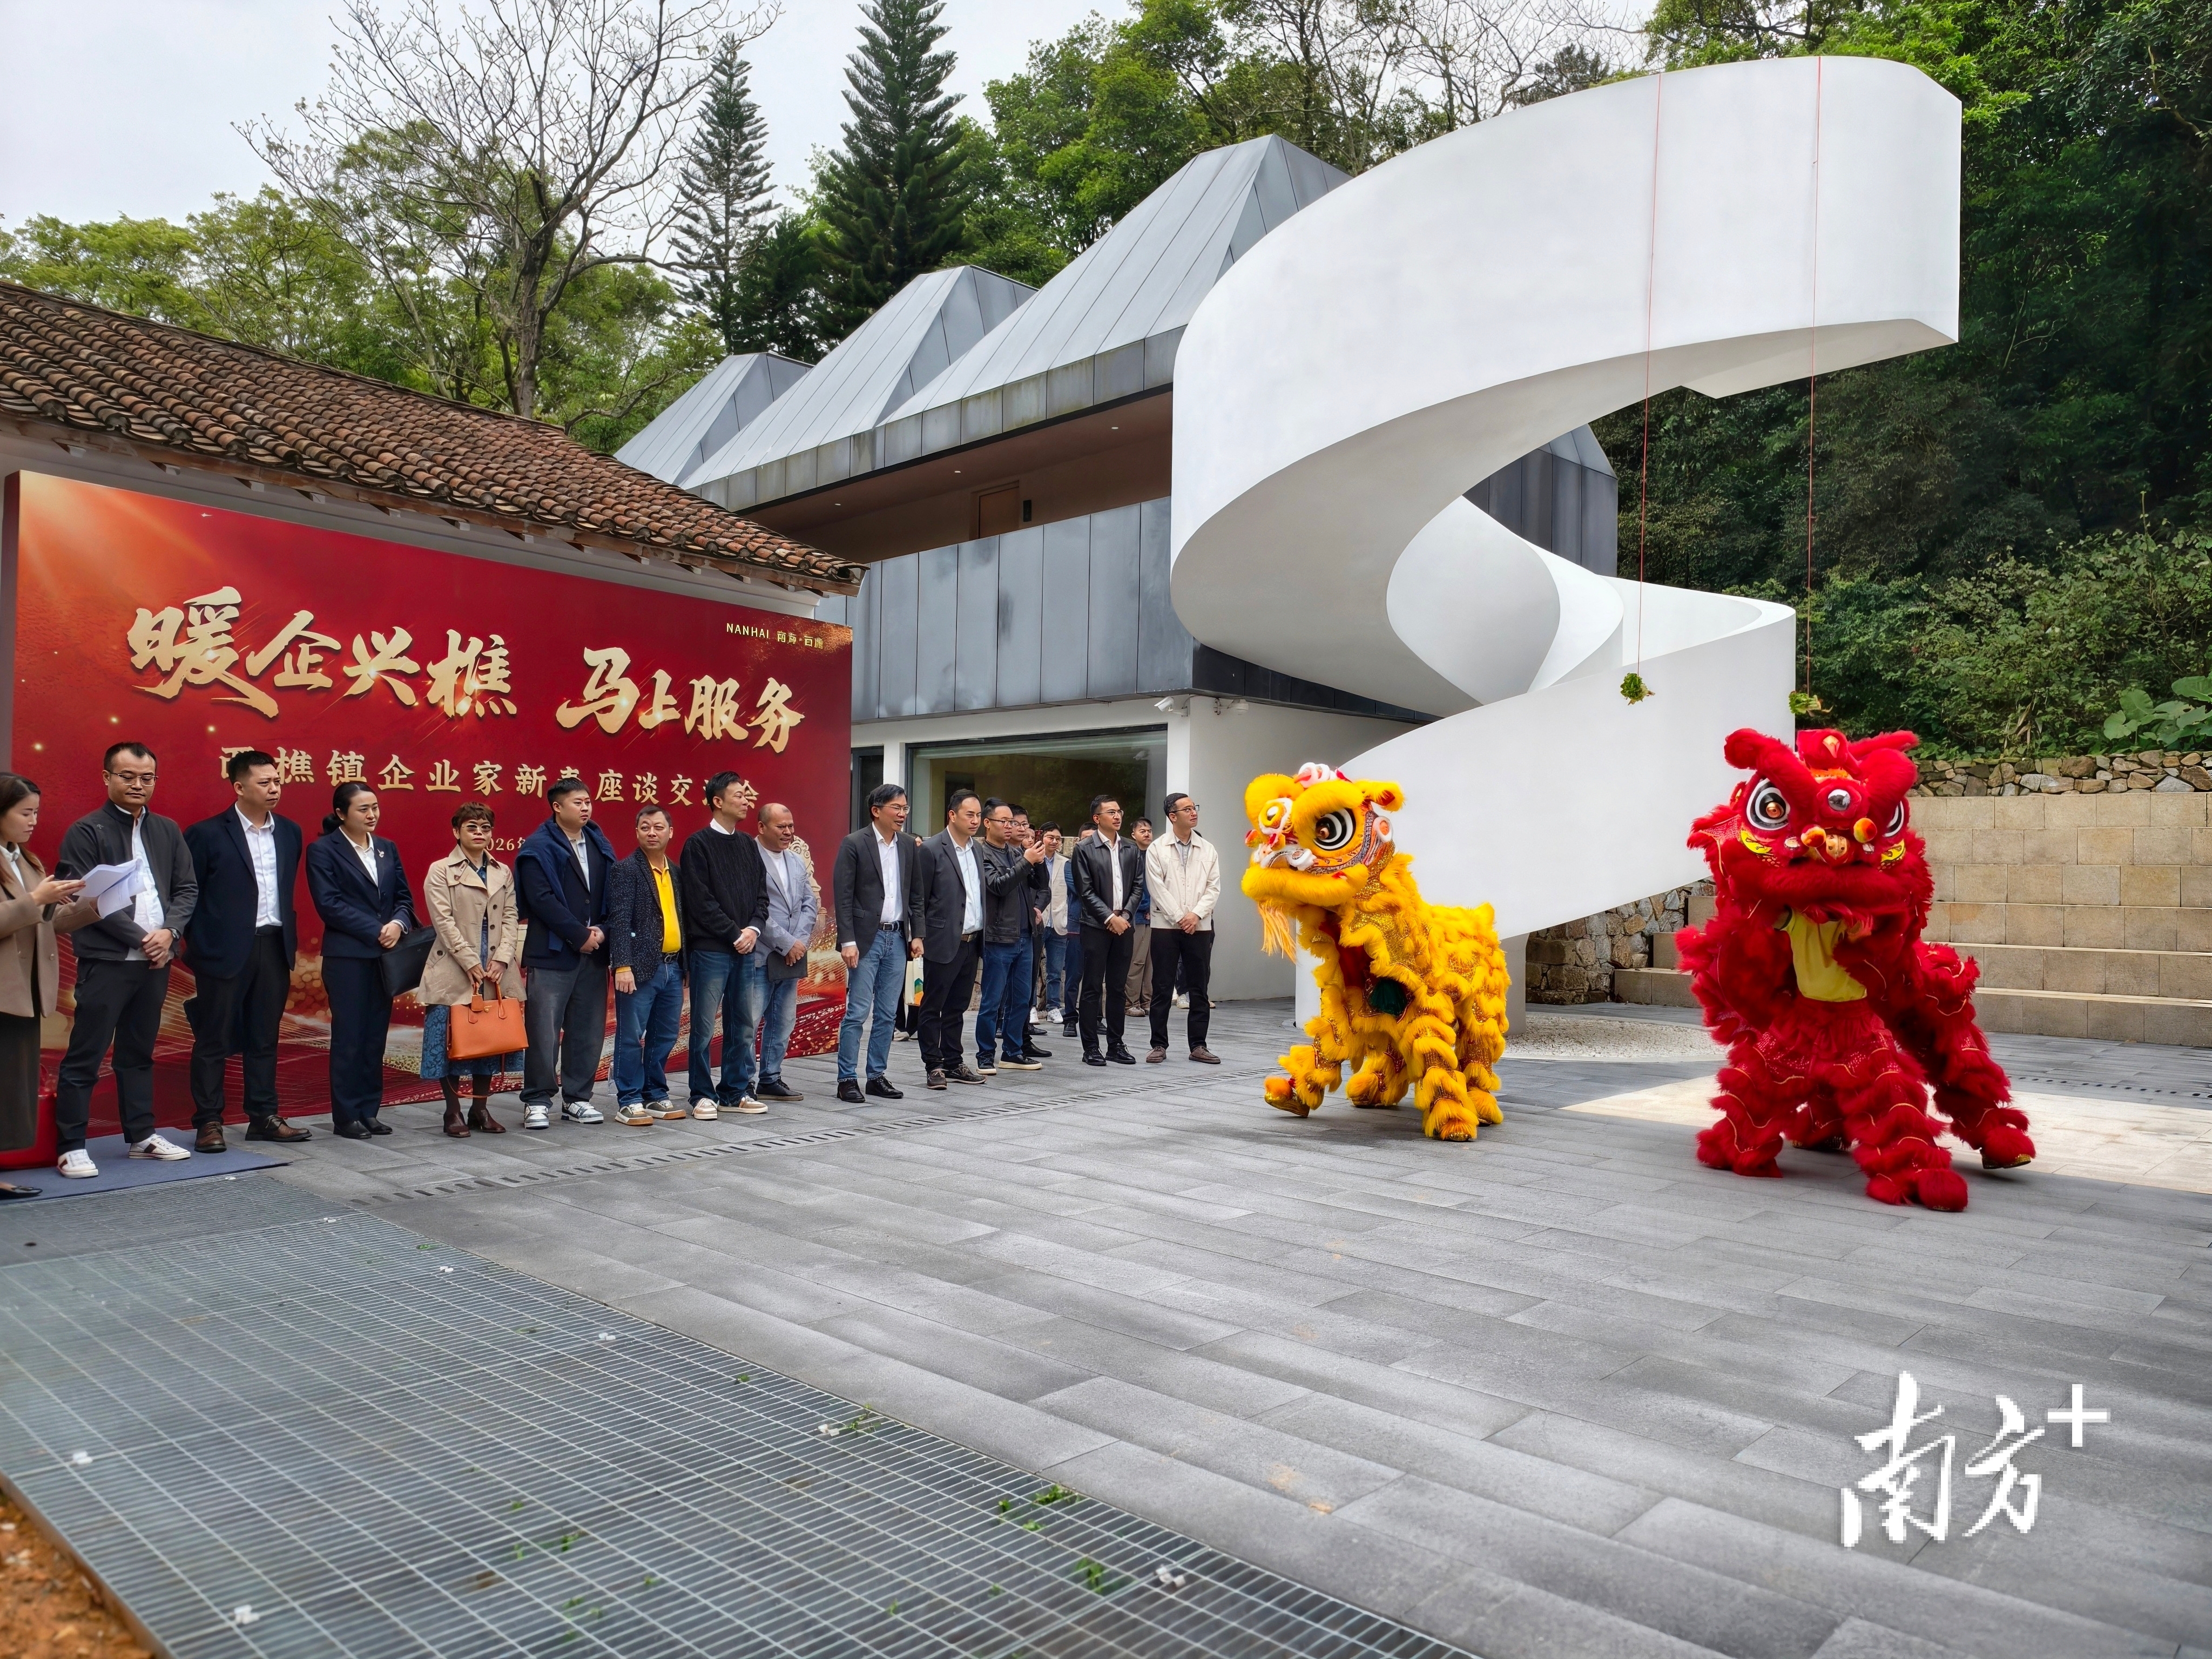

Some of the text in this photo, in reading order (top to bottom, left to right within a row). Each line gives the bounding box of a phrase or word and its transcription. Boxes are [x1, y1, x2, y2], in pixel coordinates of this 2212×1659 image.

[726, 623, 769, 639] NANHAI
[127, 586, 805, 753] 暖企兴樵 马上服务
[218, 746, 759, 809] 樵镇企业家新座谈交会
